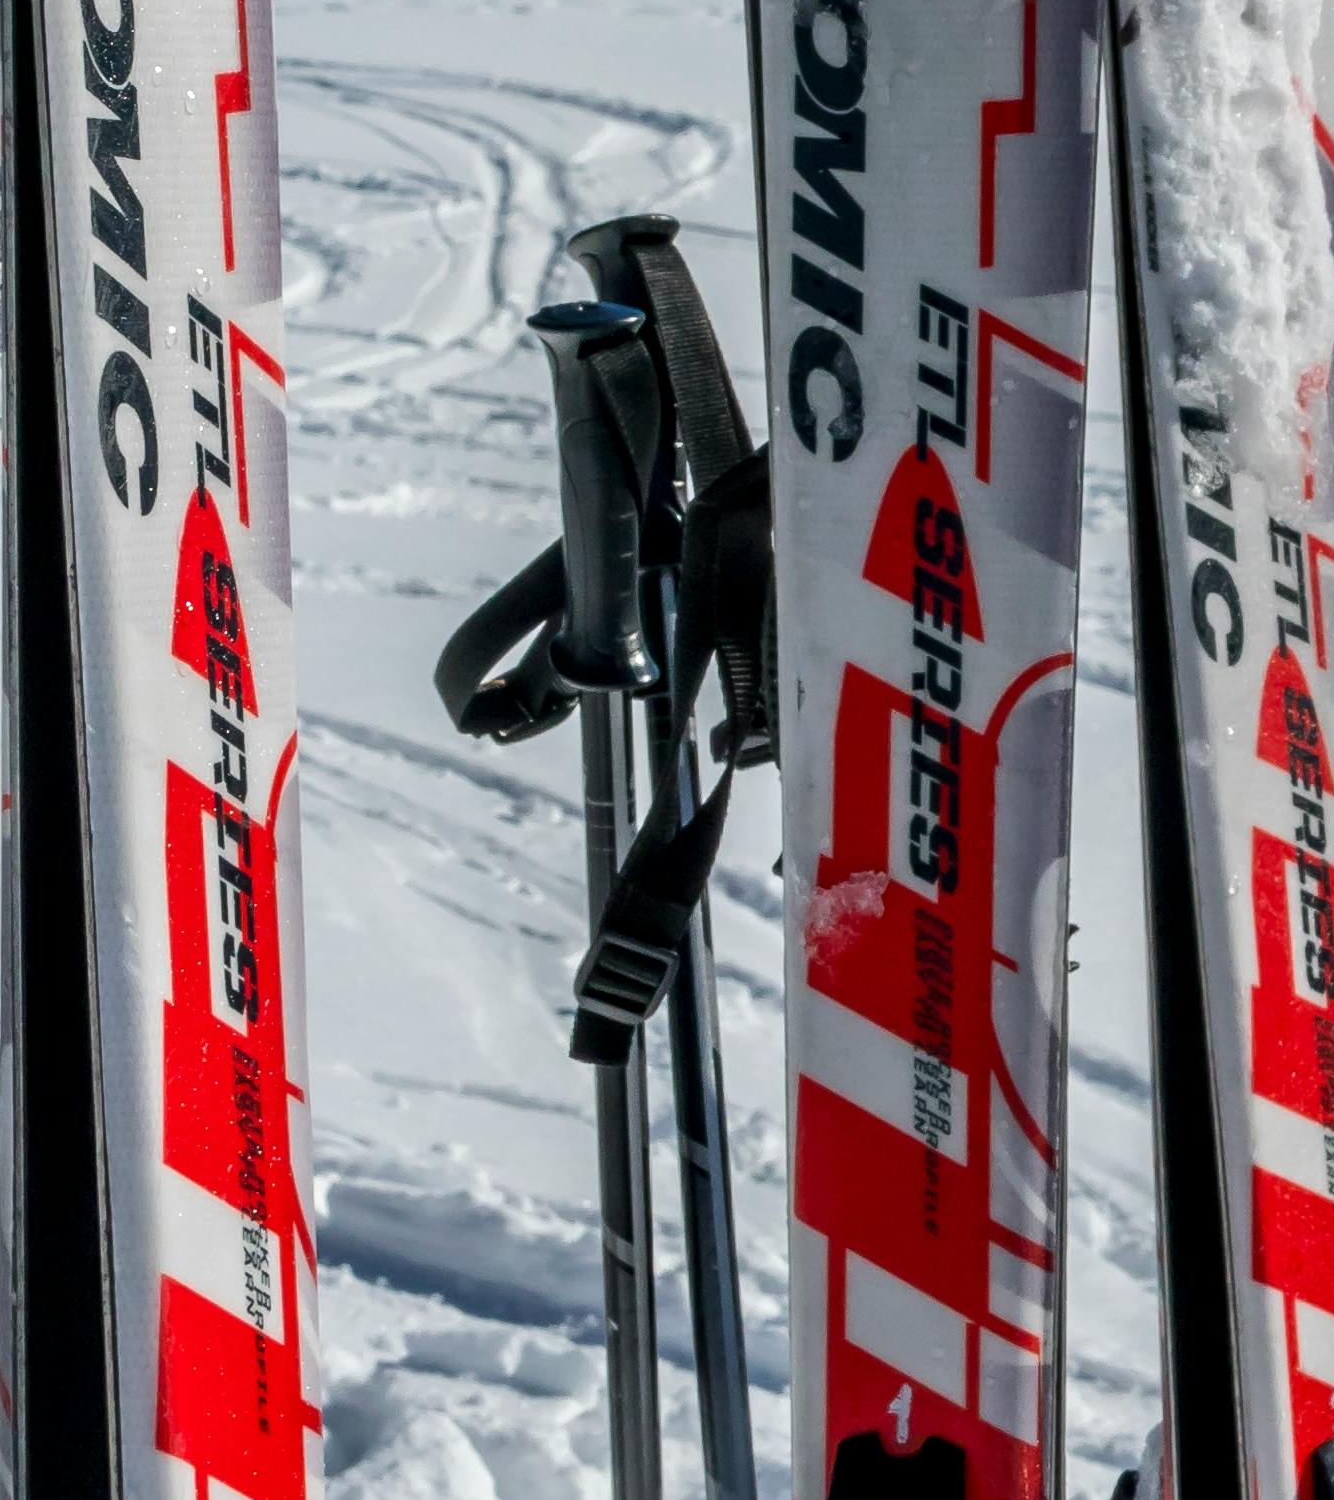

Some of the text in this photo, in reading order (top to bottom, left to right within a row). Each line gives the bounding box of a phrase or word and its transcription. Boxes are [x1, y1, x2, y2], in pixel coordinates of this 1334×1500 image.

[186, 293, 231, 509] ETL
[916, 283, 969, 462] ETL
[1266, 517, 1310, 659] ETL
[199, 551, 259, 1028] SERIES
[908, 497, 965, 900] SERIES
[886, 1382, 913, 1444] 1
